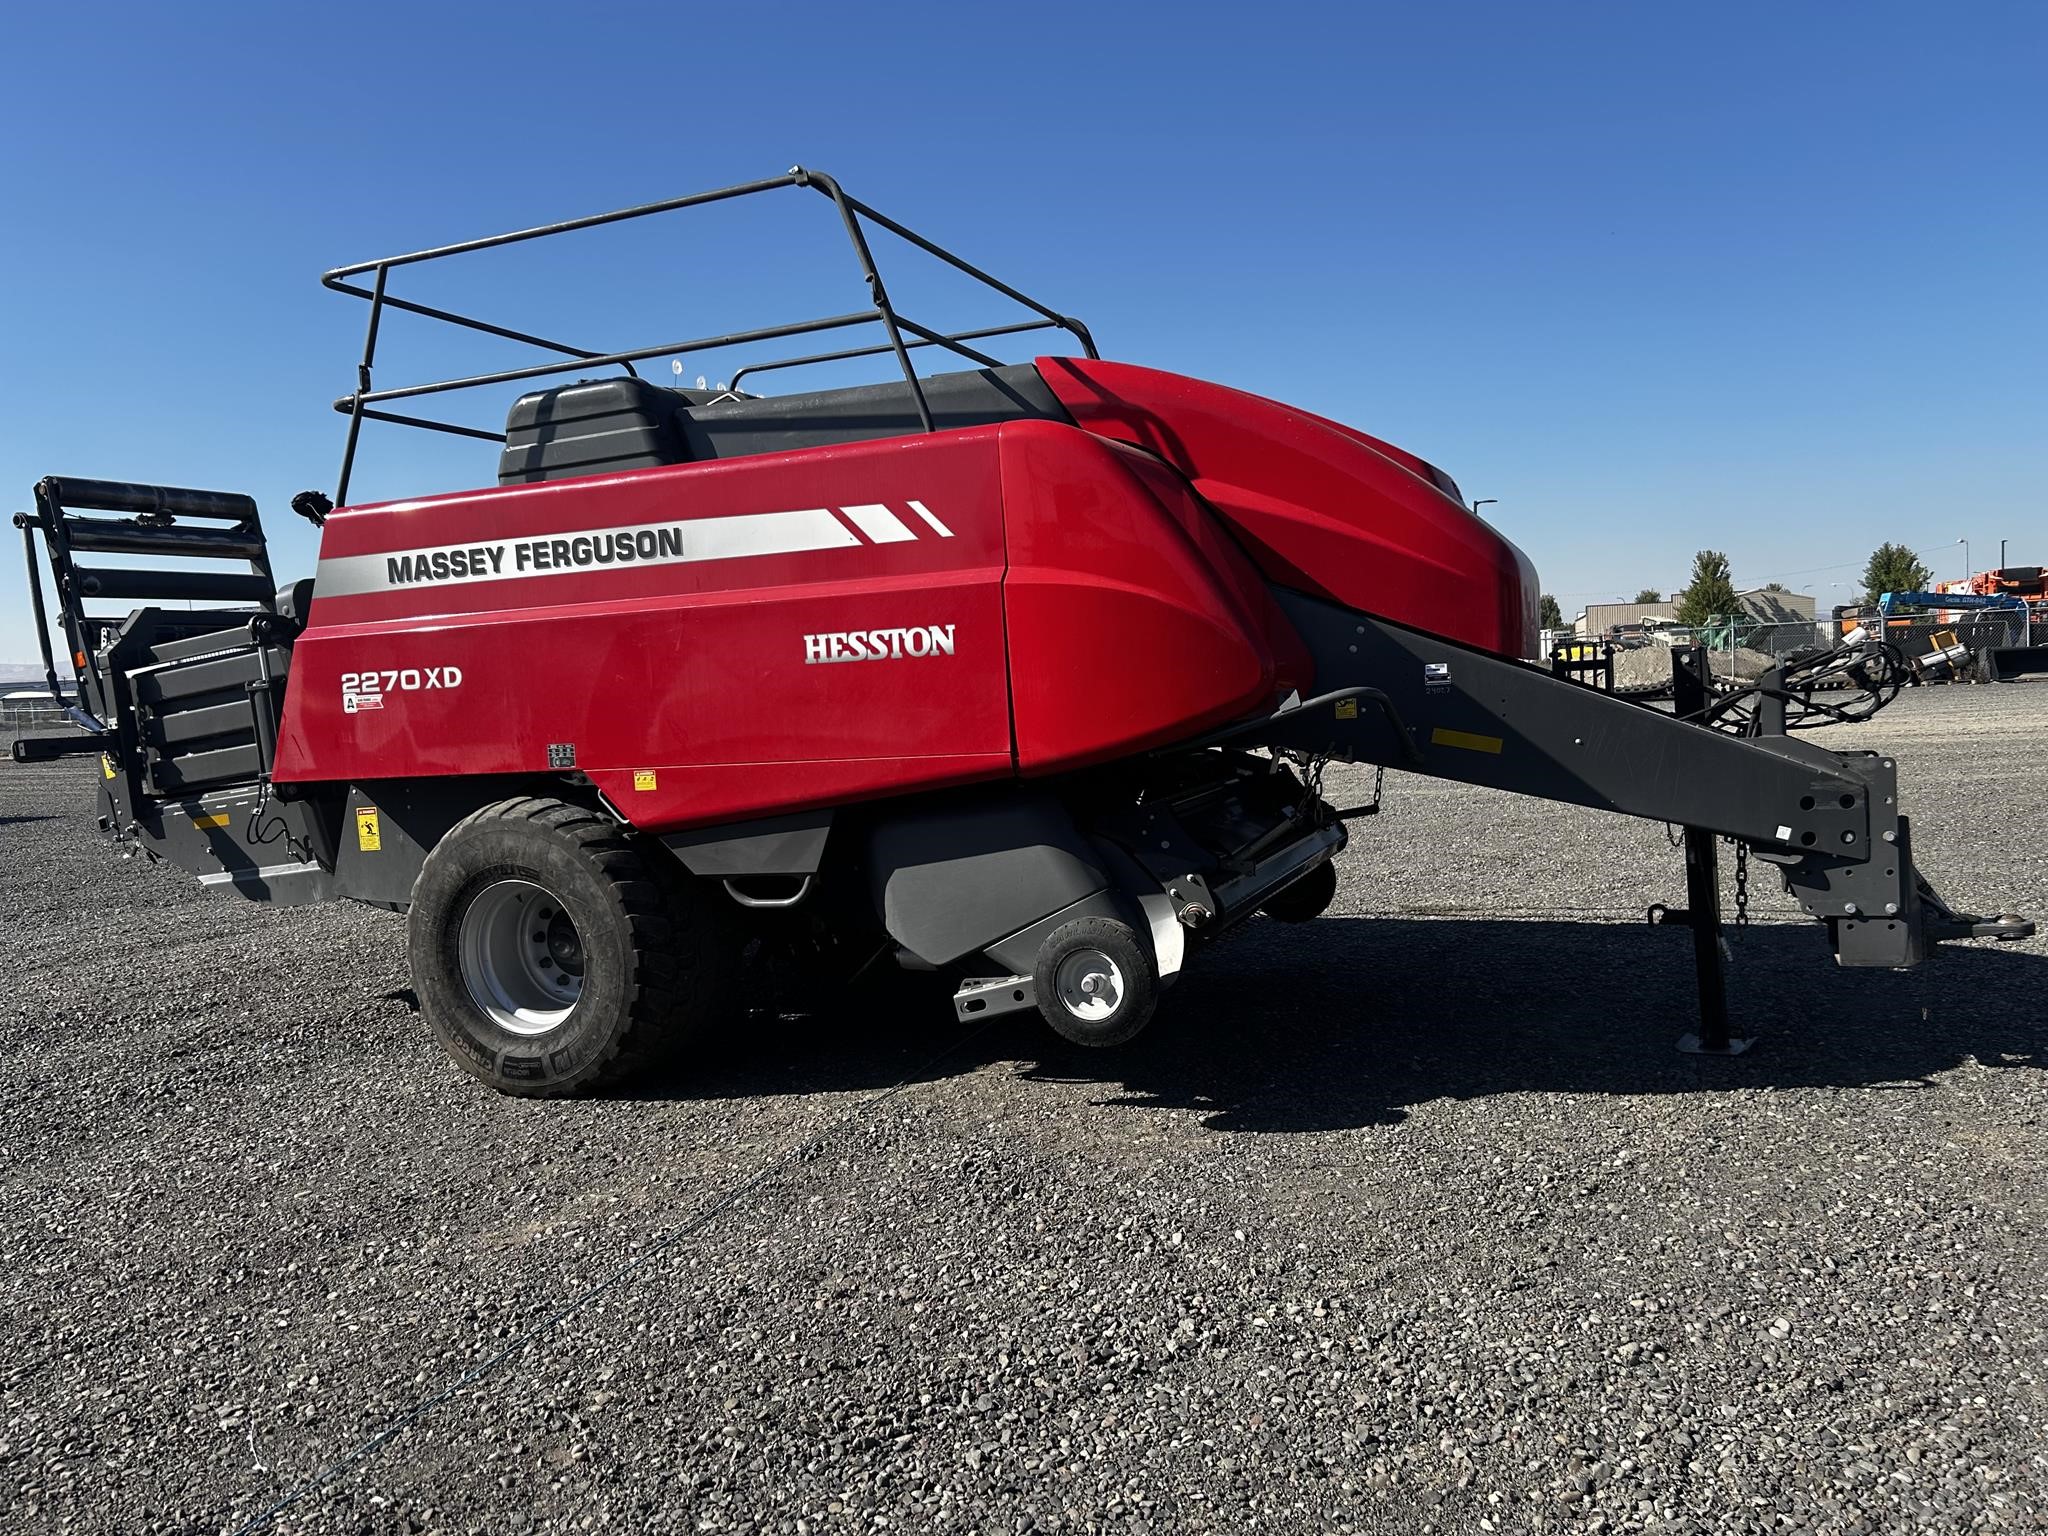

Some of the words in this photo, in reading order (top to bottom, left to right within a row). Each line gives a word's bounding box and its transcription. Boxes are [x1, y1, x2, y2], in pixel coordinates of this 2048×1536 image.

[387, 545, 505, 584] MASSEY
[515, 527, 684, 572] FERGUSON
[803, 624, 956, 664] HESSTON
